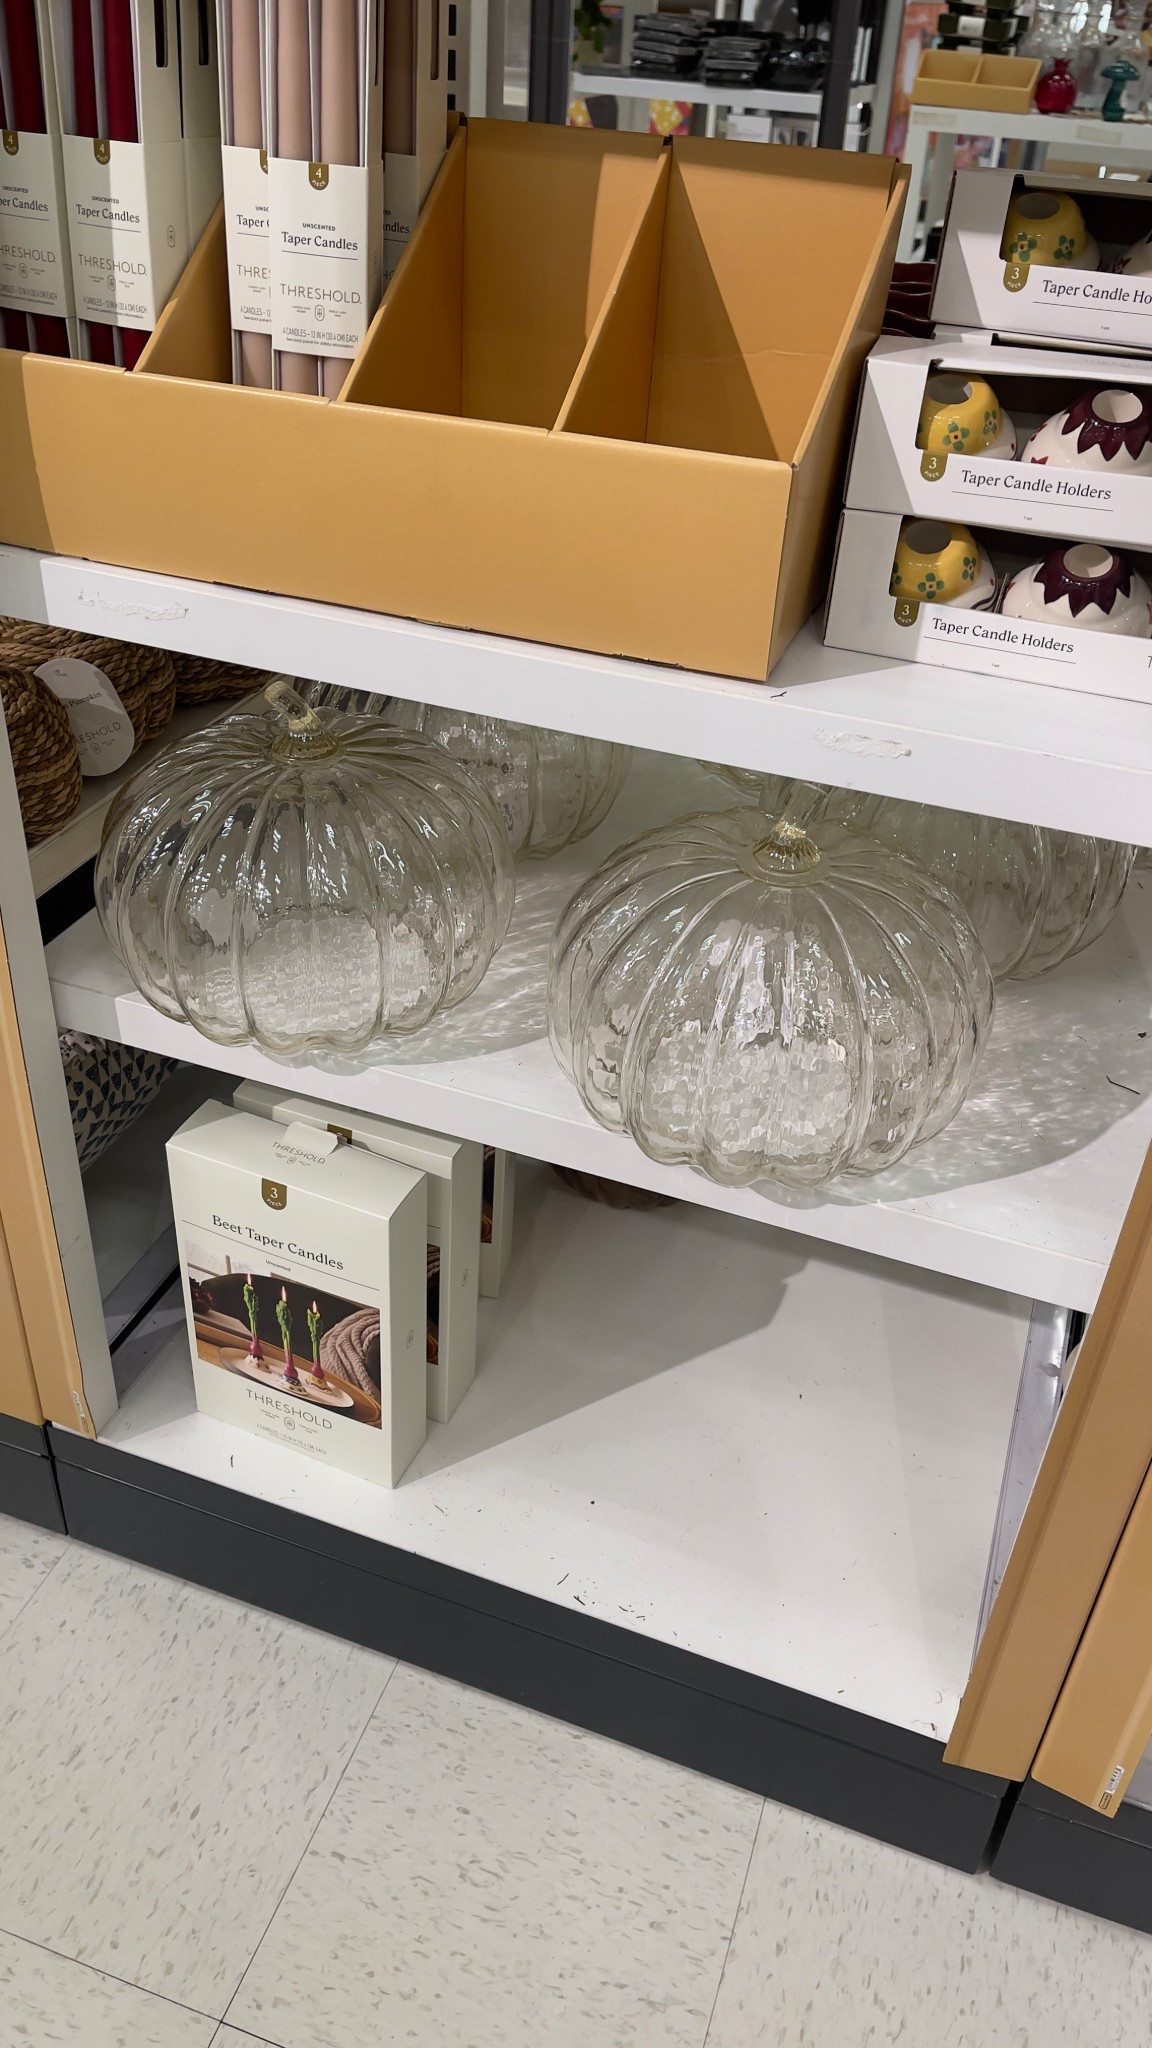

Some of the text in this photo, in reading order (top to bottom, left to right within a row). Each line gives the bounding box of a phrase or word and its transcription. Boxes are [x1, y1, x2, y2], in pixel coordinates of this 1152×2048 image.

[7, 134, 14, 145] 4
[99, 143, 106, 154] 4
[315, 167, 323, 179] 4
[12, 198, 49, 212] Candles
[91, 195, 120, 205] UNSCENTED
[76, 203, 141, 224] Taper Candles
[236, 213, 265, 228] Taper
[302, 222, 336, 232] UNSCENTED
[281, 231, 358, 251] Taper Candles
[78, 253, 147, 276] THRESHOLD
[1011, 267, 1020, 280] 3
[280, 283, 362, 304] THRESHOLD
[1042, 279, 1081, 298] Taper
[1082, 284, 1130, 302] Candle
[286, 327, 307, 338] CANDLES
[345, 334, 359, 343] EACH
[928, 457, 937, 469] 3
[924, 470, 940, 478] PIECE
[961, 469, 1112, 501] Taper Candle Holders
[901, 604, 910, 616] 3
[932, 617, 1074, 653] Taper Candle Holders
[69, 691, 102, 707] Pumpkin
[272, 1141, 326, 1165] THRESHOLD
[270, 1187, 278, 1199] 3
[212, 1214, 344, 1271] Beet Taper Candles
[246, 1388, 333, 1430] THRESHOLD
